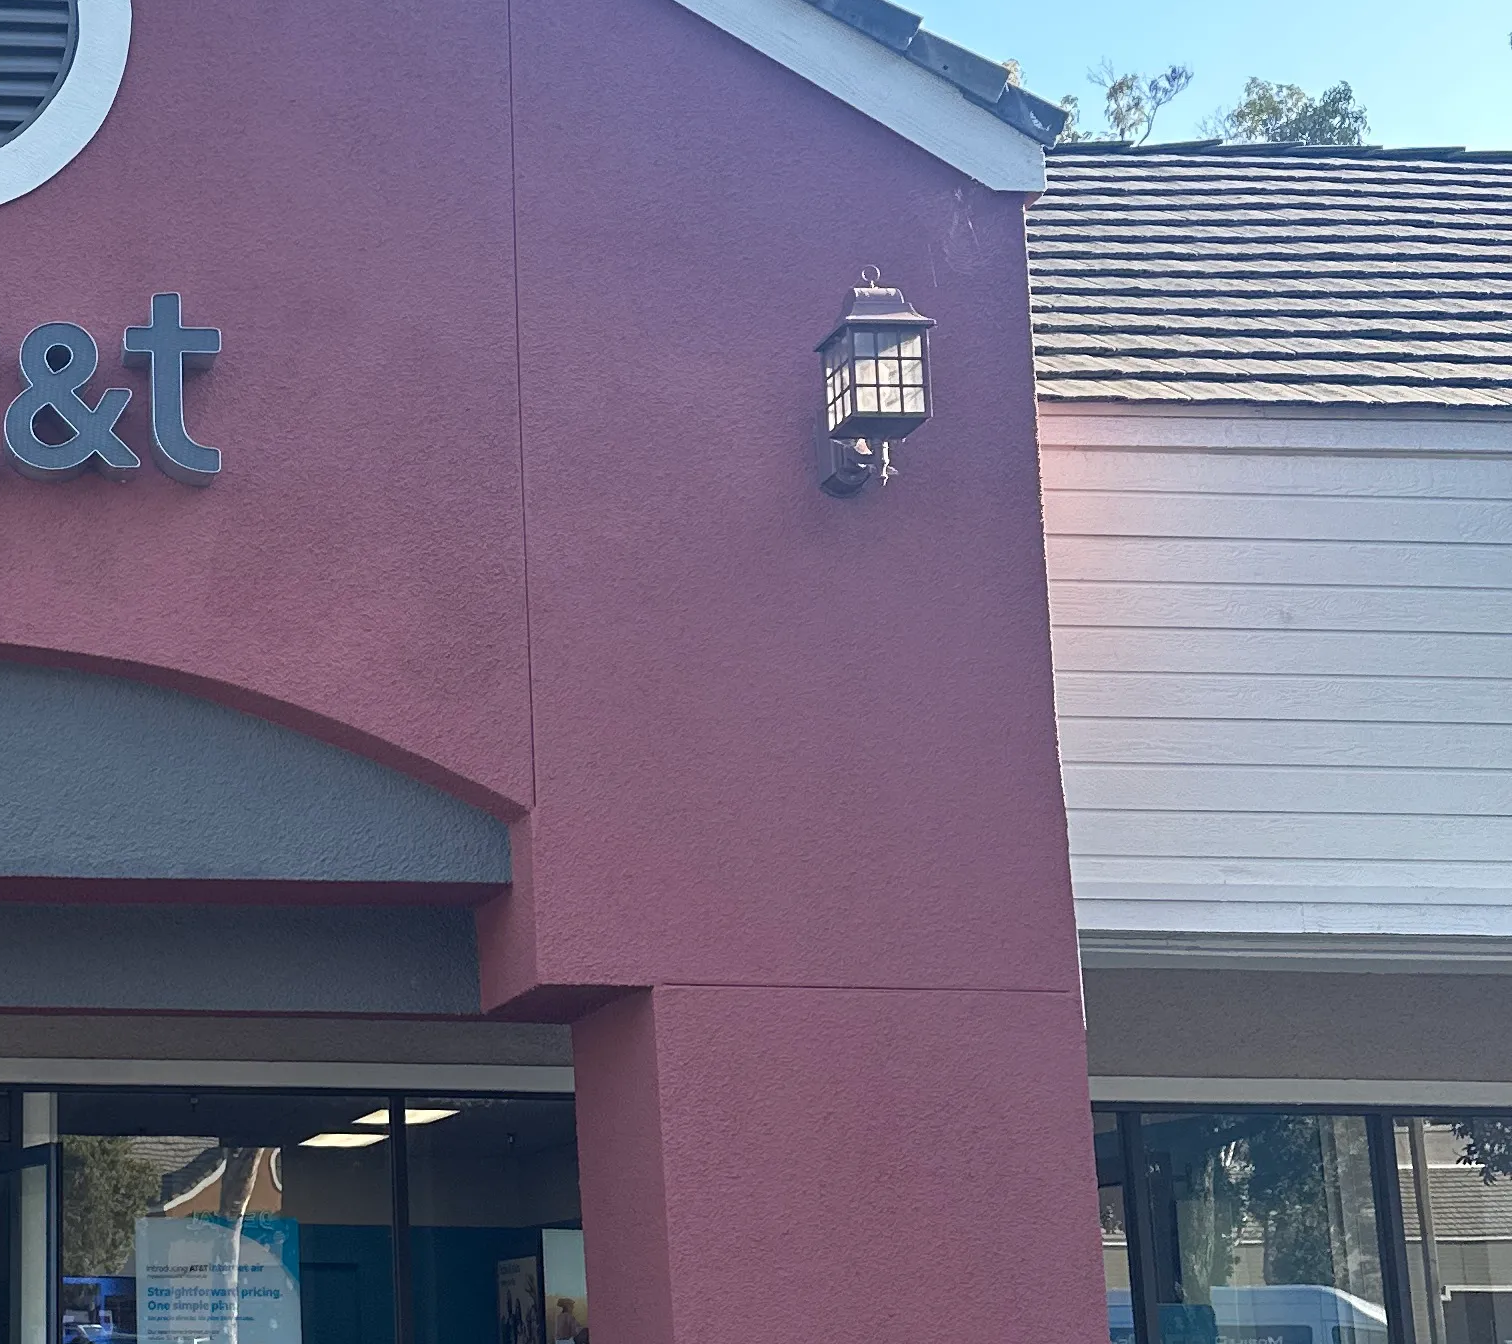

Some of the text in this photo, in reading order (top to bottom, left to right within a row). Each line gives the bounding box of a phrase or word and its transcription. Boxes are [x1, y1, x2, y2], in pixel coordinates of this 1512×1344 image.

[146, 1264, 188, 1274] Introducing
[189, 1264, 209, 1272] AT&T
[209, 1263, 249, 1273] interet
[240, 1287, 284, 1299] pricing.
[147, 1299, 239, 1312] One simple plan
